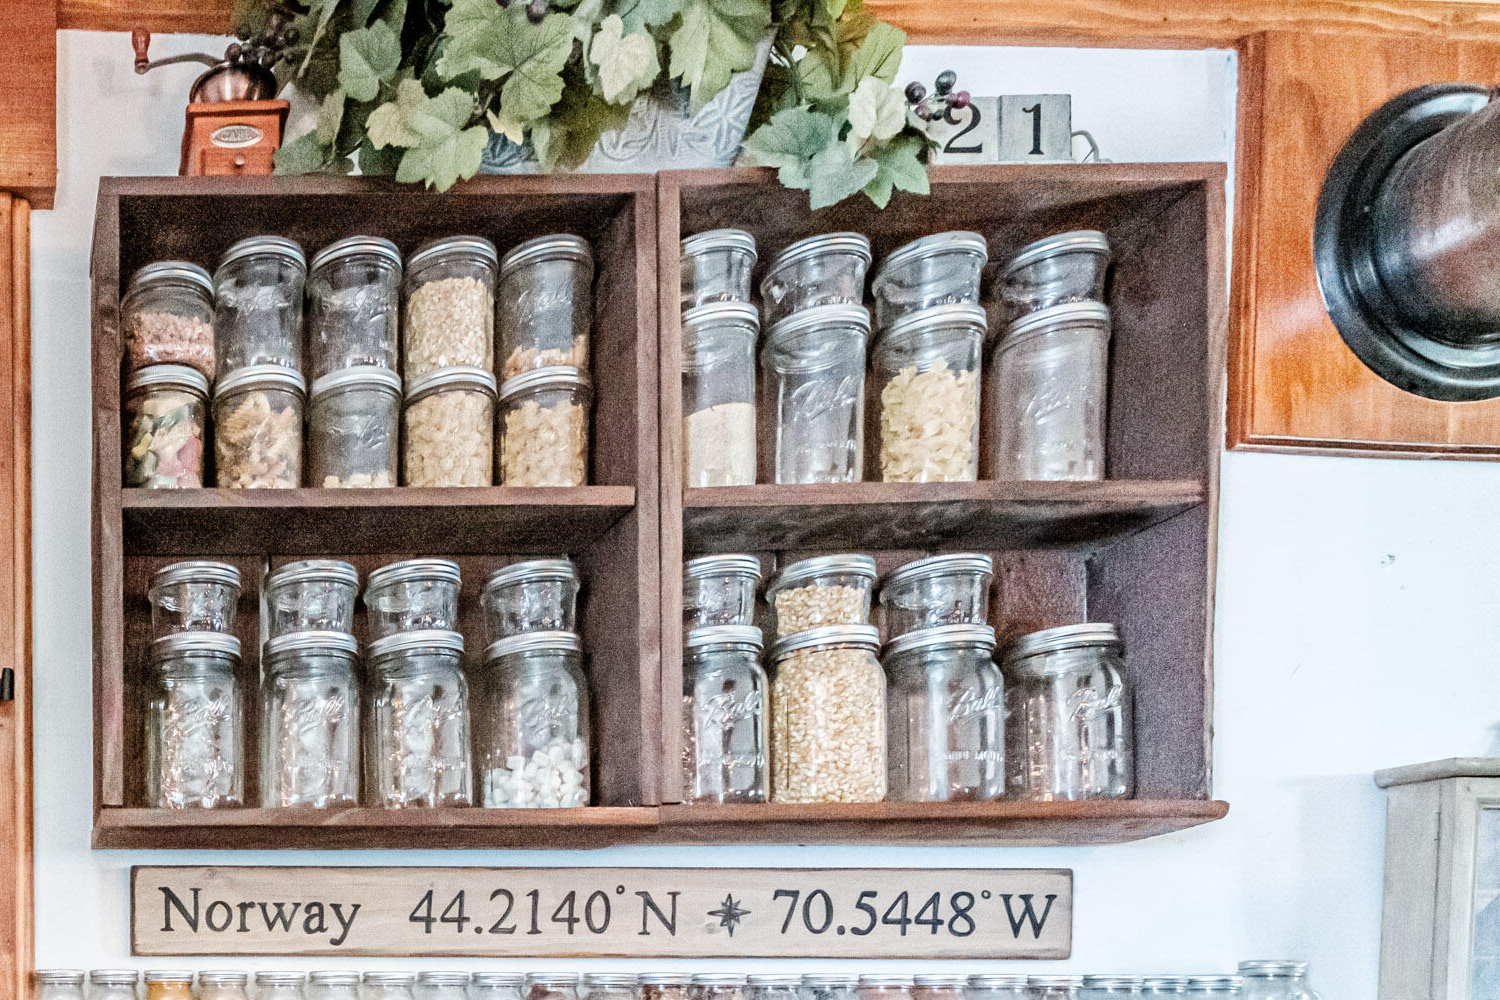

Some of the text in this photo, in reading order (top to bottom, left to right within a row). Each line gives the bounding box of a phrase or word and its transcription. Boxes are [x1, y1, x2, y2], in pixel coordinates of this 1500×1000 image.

[949, 685, 1002, 724] Ball
[1066, 684, 1124, 722] Ball
[157, 886, 362, 946] Norway
